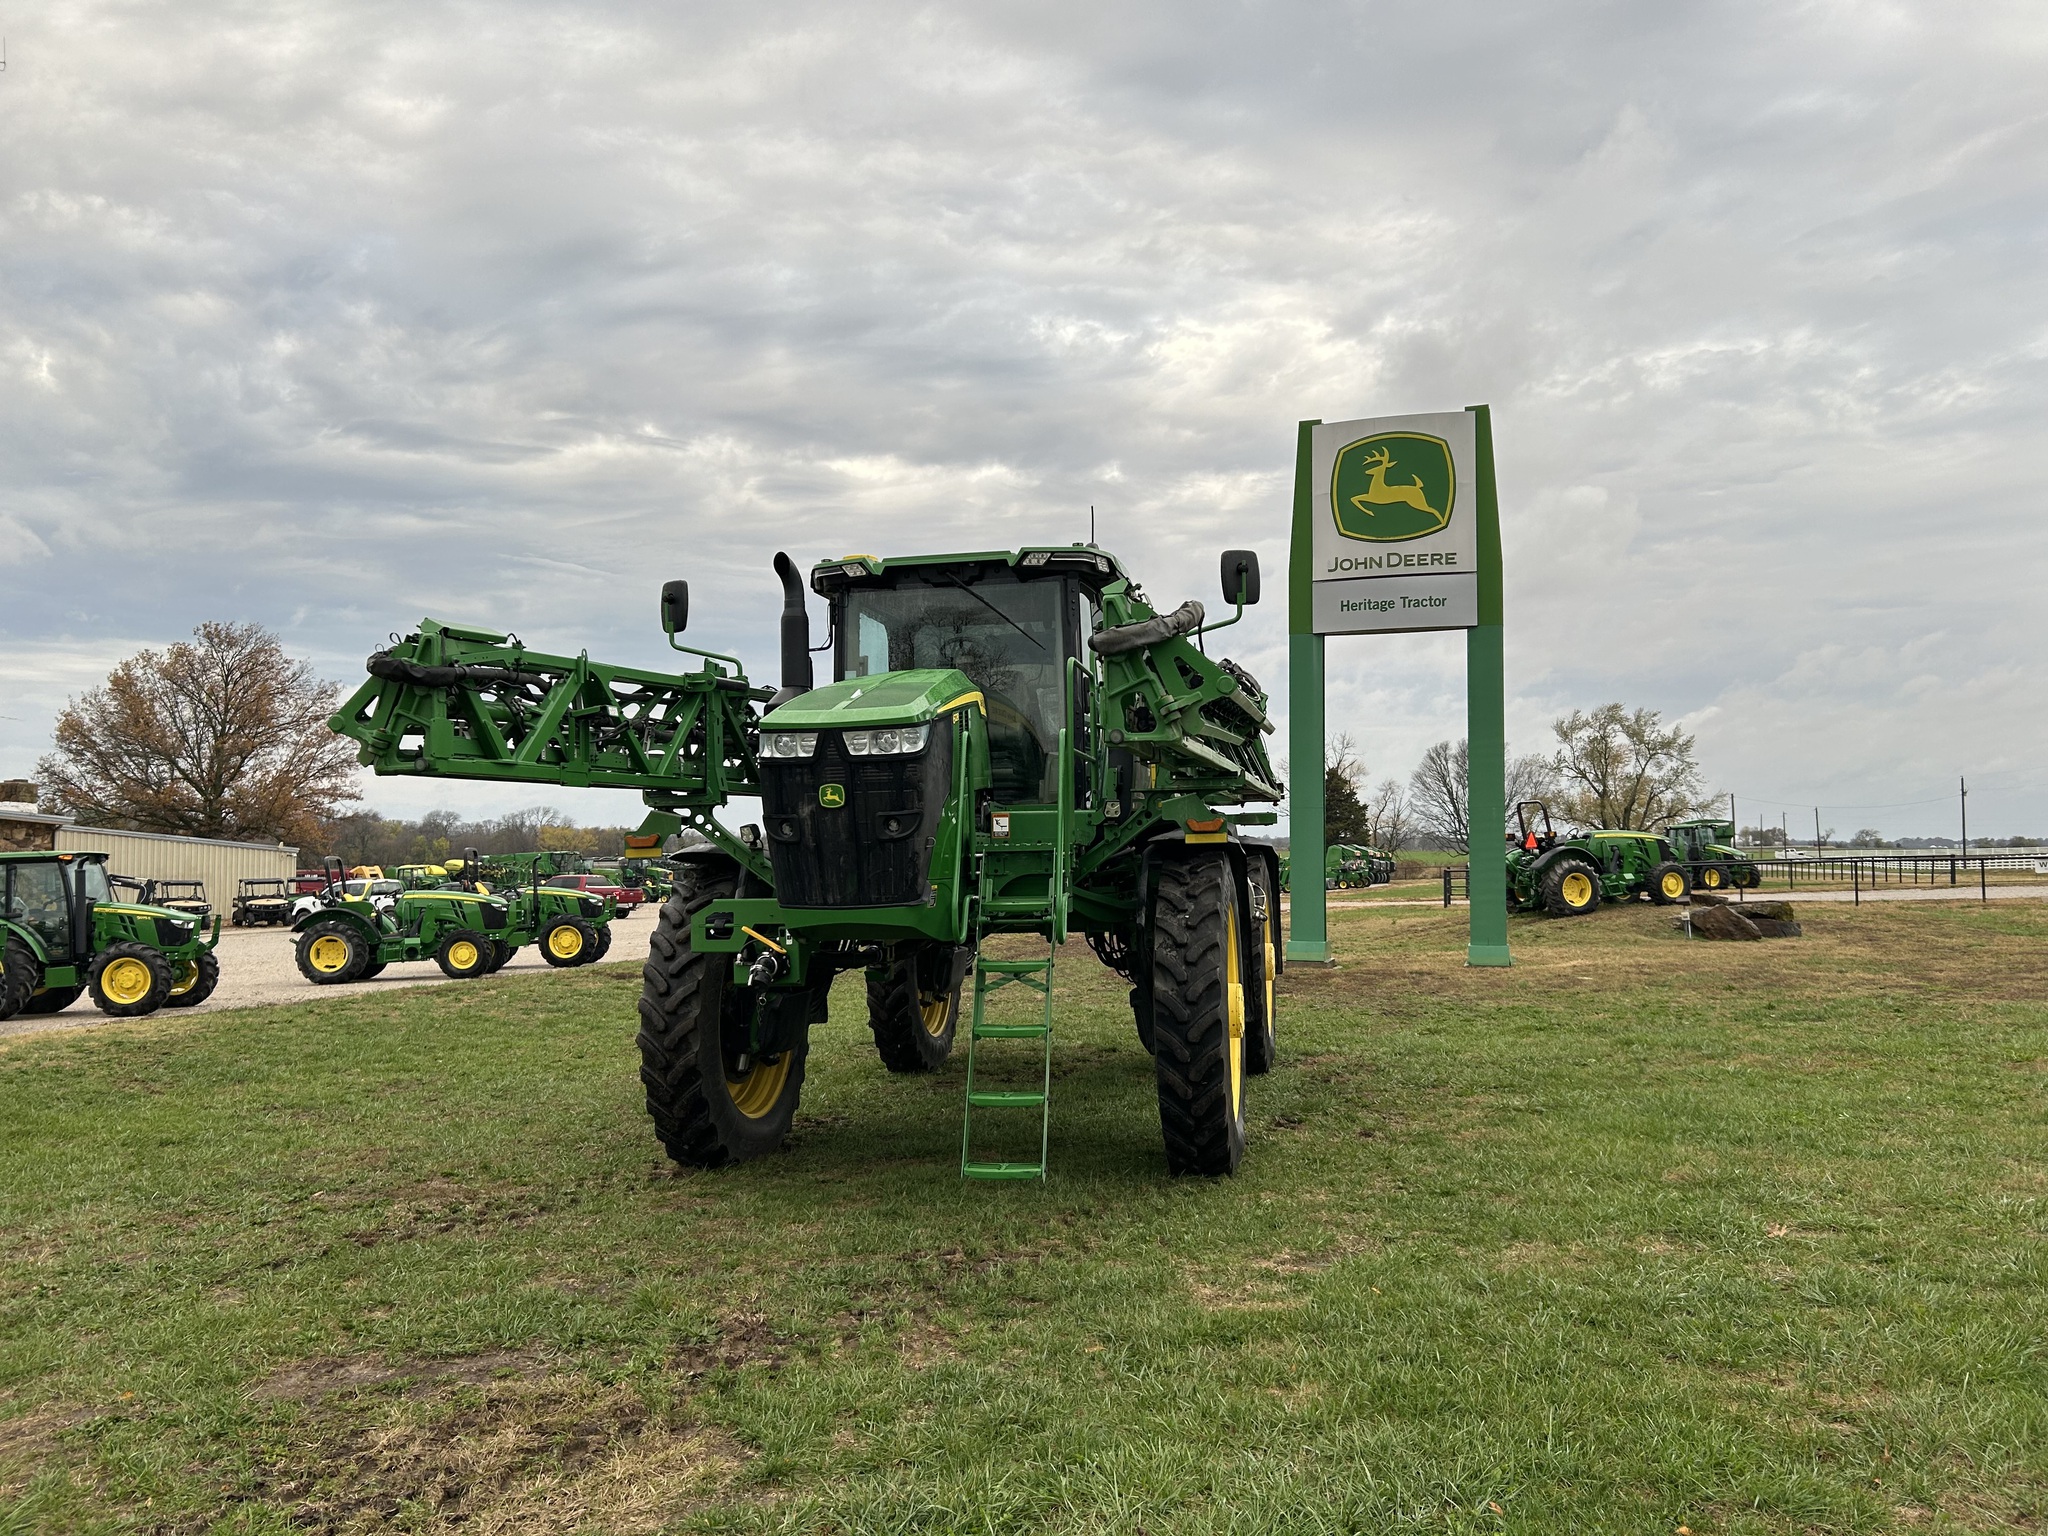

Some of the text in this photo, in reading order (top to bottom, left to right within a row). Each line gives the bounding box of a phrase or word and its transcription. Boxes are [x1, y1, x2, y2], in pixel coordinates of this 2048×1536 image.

[1327, 552, 1458, 573] JOHN DEERE
[1340, 595, 1448, 612] Heritage Tractor
